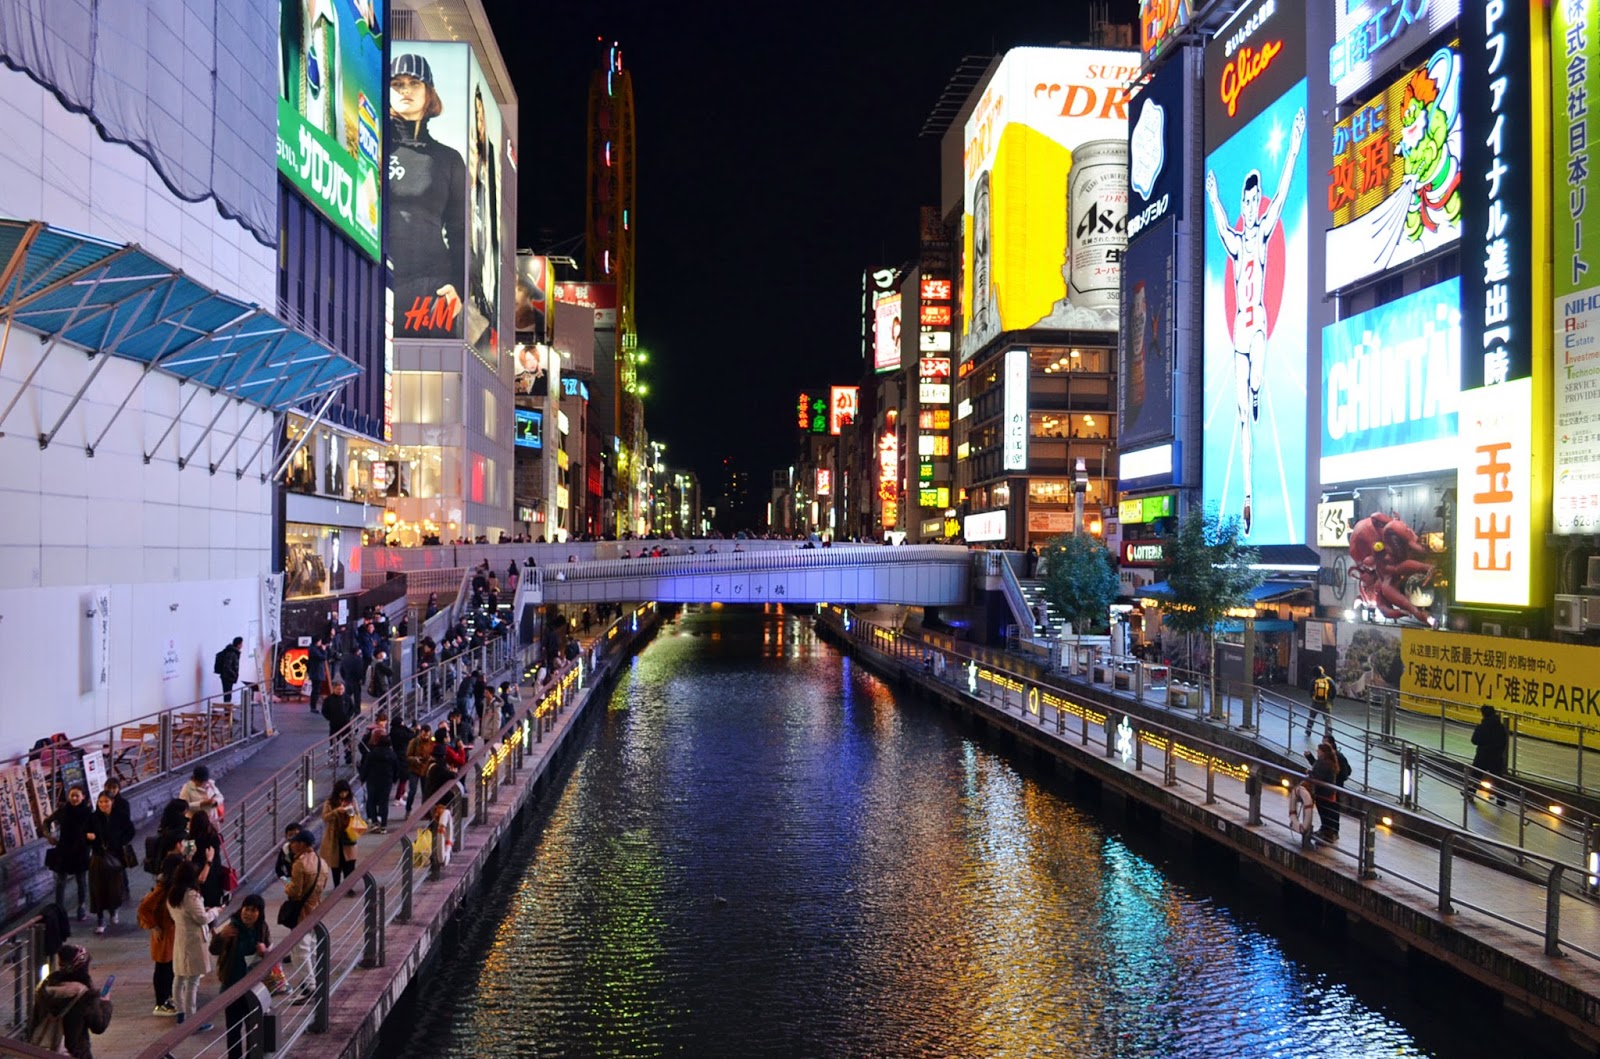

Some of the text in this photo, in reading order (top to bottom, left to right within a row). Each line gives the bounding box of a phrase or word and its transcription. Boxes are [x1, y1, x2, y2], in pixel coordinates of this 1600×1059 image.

[1221, 41, 1282, 117] Glico
[1332, 104, 1385, 156] かぜに
[299, 124, 354, 227] サロンパス
[1328, 131, 1389, 212] 改源
[405, 296, 457, 332] H&M
[1565, 317, 1588, 332] Real
[1565, 334, 1595, 348] Estate
[1565, 350, 1600, 365] Investme
[1565, 379, 1597, 393] SERVICE
[1473, 442, 1513, 571] 玉出
[1134, 545, 1163, 560] LOTTERIA
